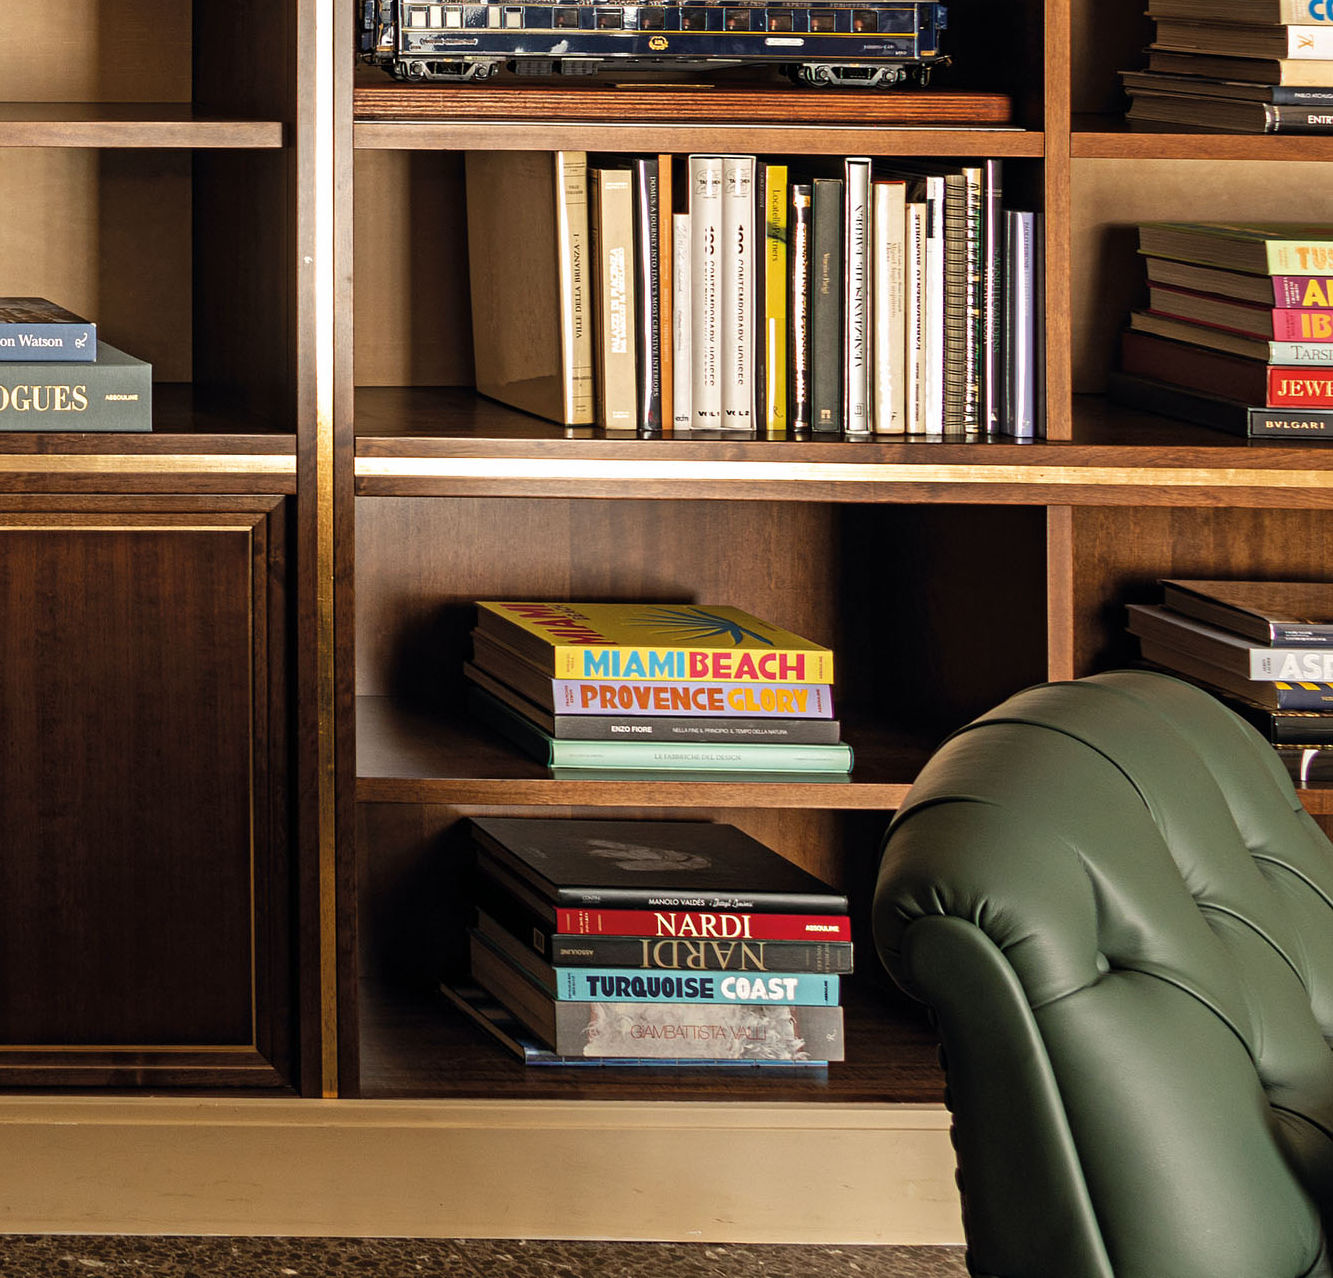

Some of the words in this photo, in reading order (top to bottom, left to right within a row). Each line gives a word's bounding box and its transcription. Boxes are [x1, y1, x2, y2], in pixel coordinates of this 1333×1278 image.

[18, 334, 63, 347] Watson
[1266, 421, 1325, 429] BVLGARI
[584, 650, 685, 678] MIAMI
[690, 652, 806, 680] BEACH
[580, 684, 724, 711] PROVENCE
[727, 690, 808, 713] GLORY
[655, 913, 752, 938] NARDI
[640, 939, 768, 971] NARDI
[587, 976, 714, 998] TURQUOISE
[721, 977, 798, 1001] COAST
